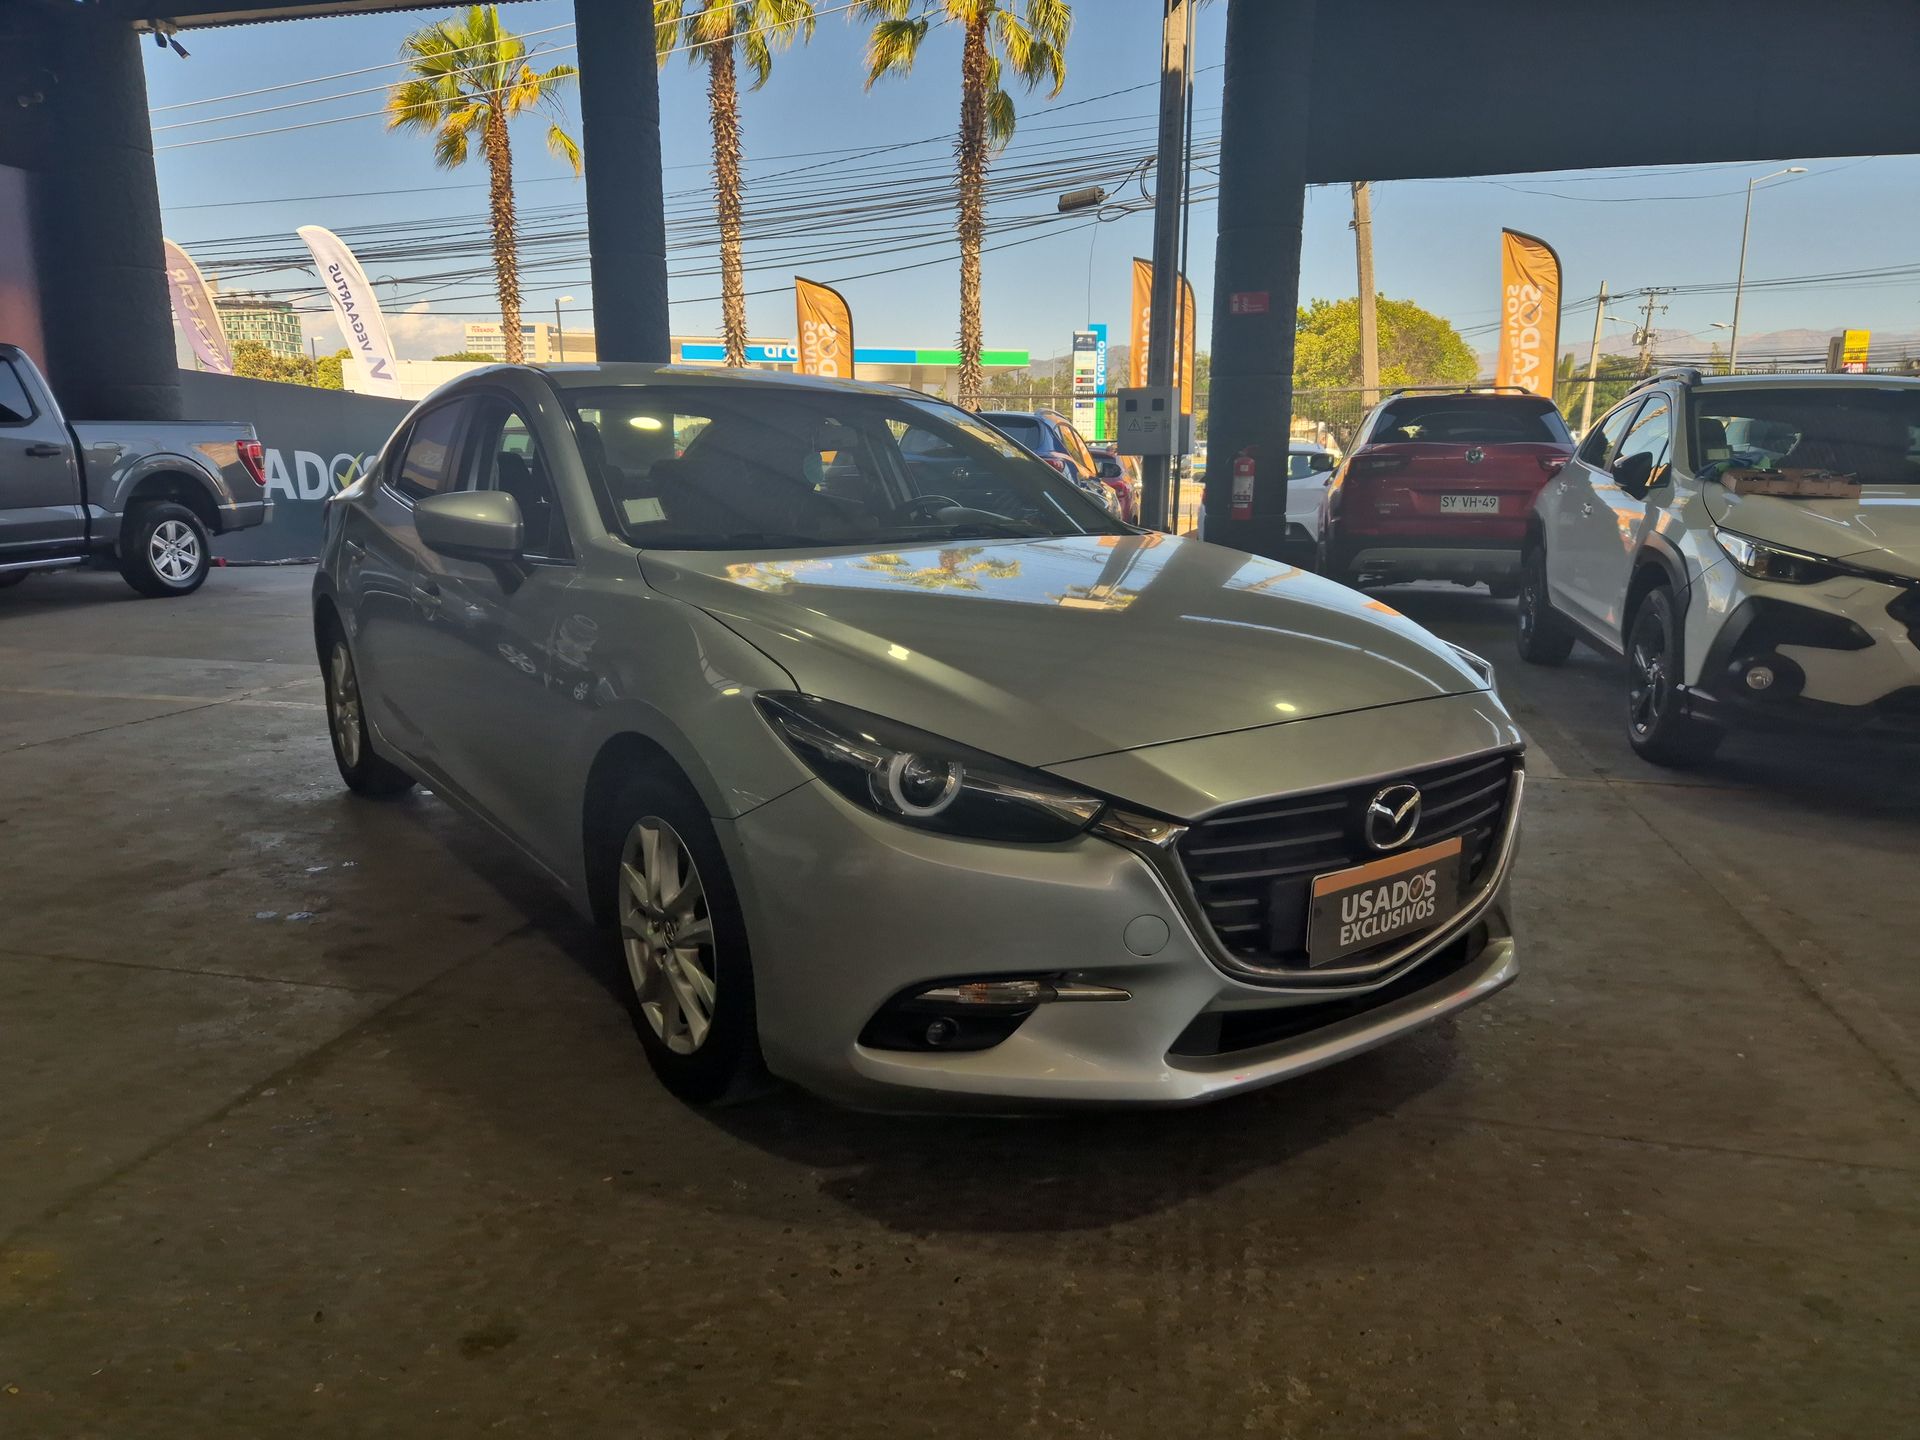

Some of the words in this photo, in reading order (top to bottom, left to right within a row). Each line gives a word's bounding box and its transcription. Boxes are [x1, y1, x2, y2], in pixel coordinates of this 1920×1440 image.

[1097, 340, 1106, 386] aramco
[1442, 496, 1457, 508] SY
[1341, 869, 1437, 923] USADOS
[1339, 897, 1436, 947] EXCLUSIVOS
